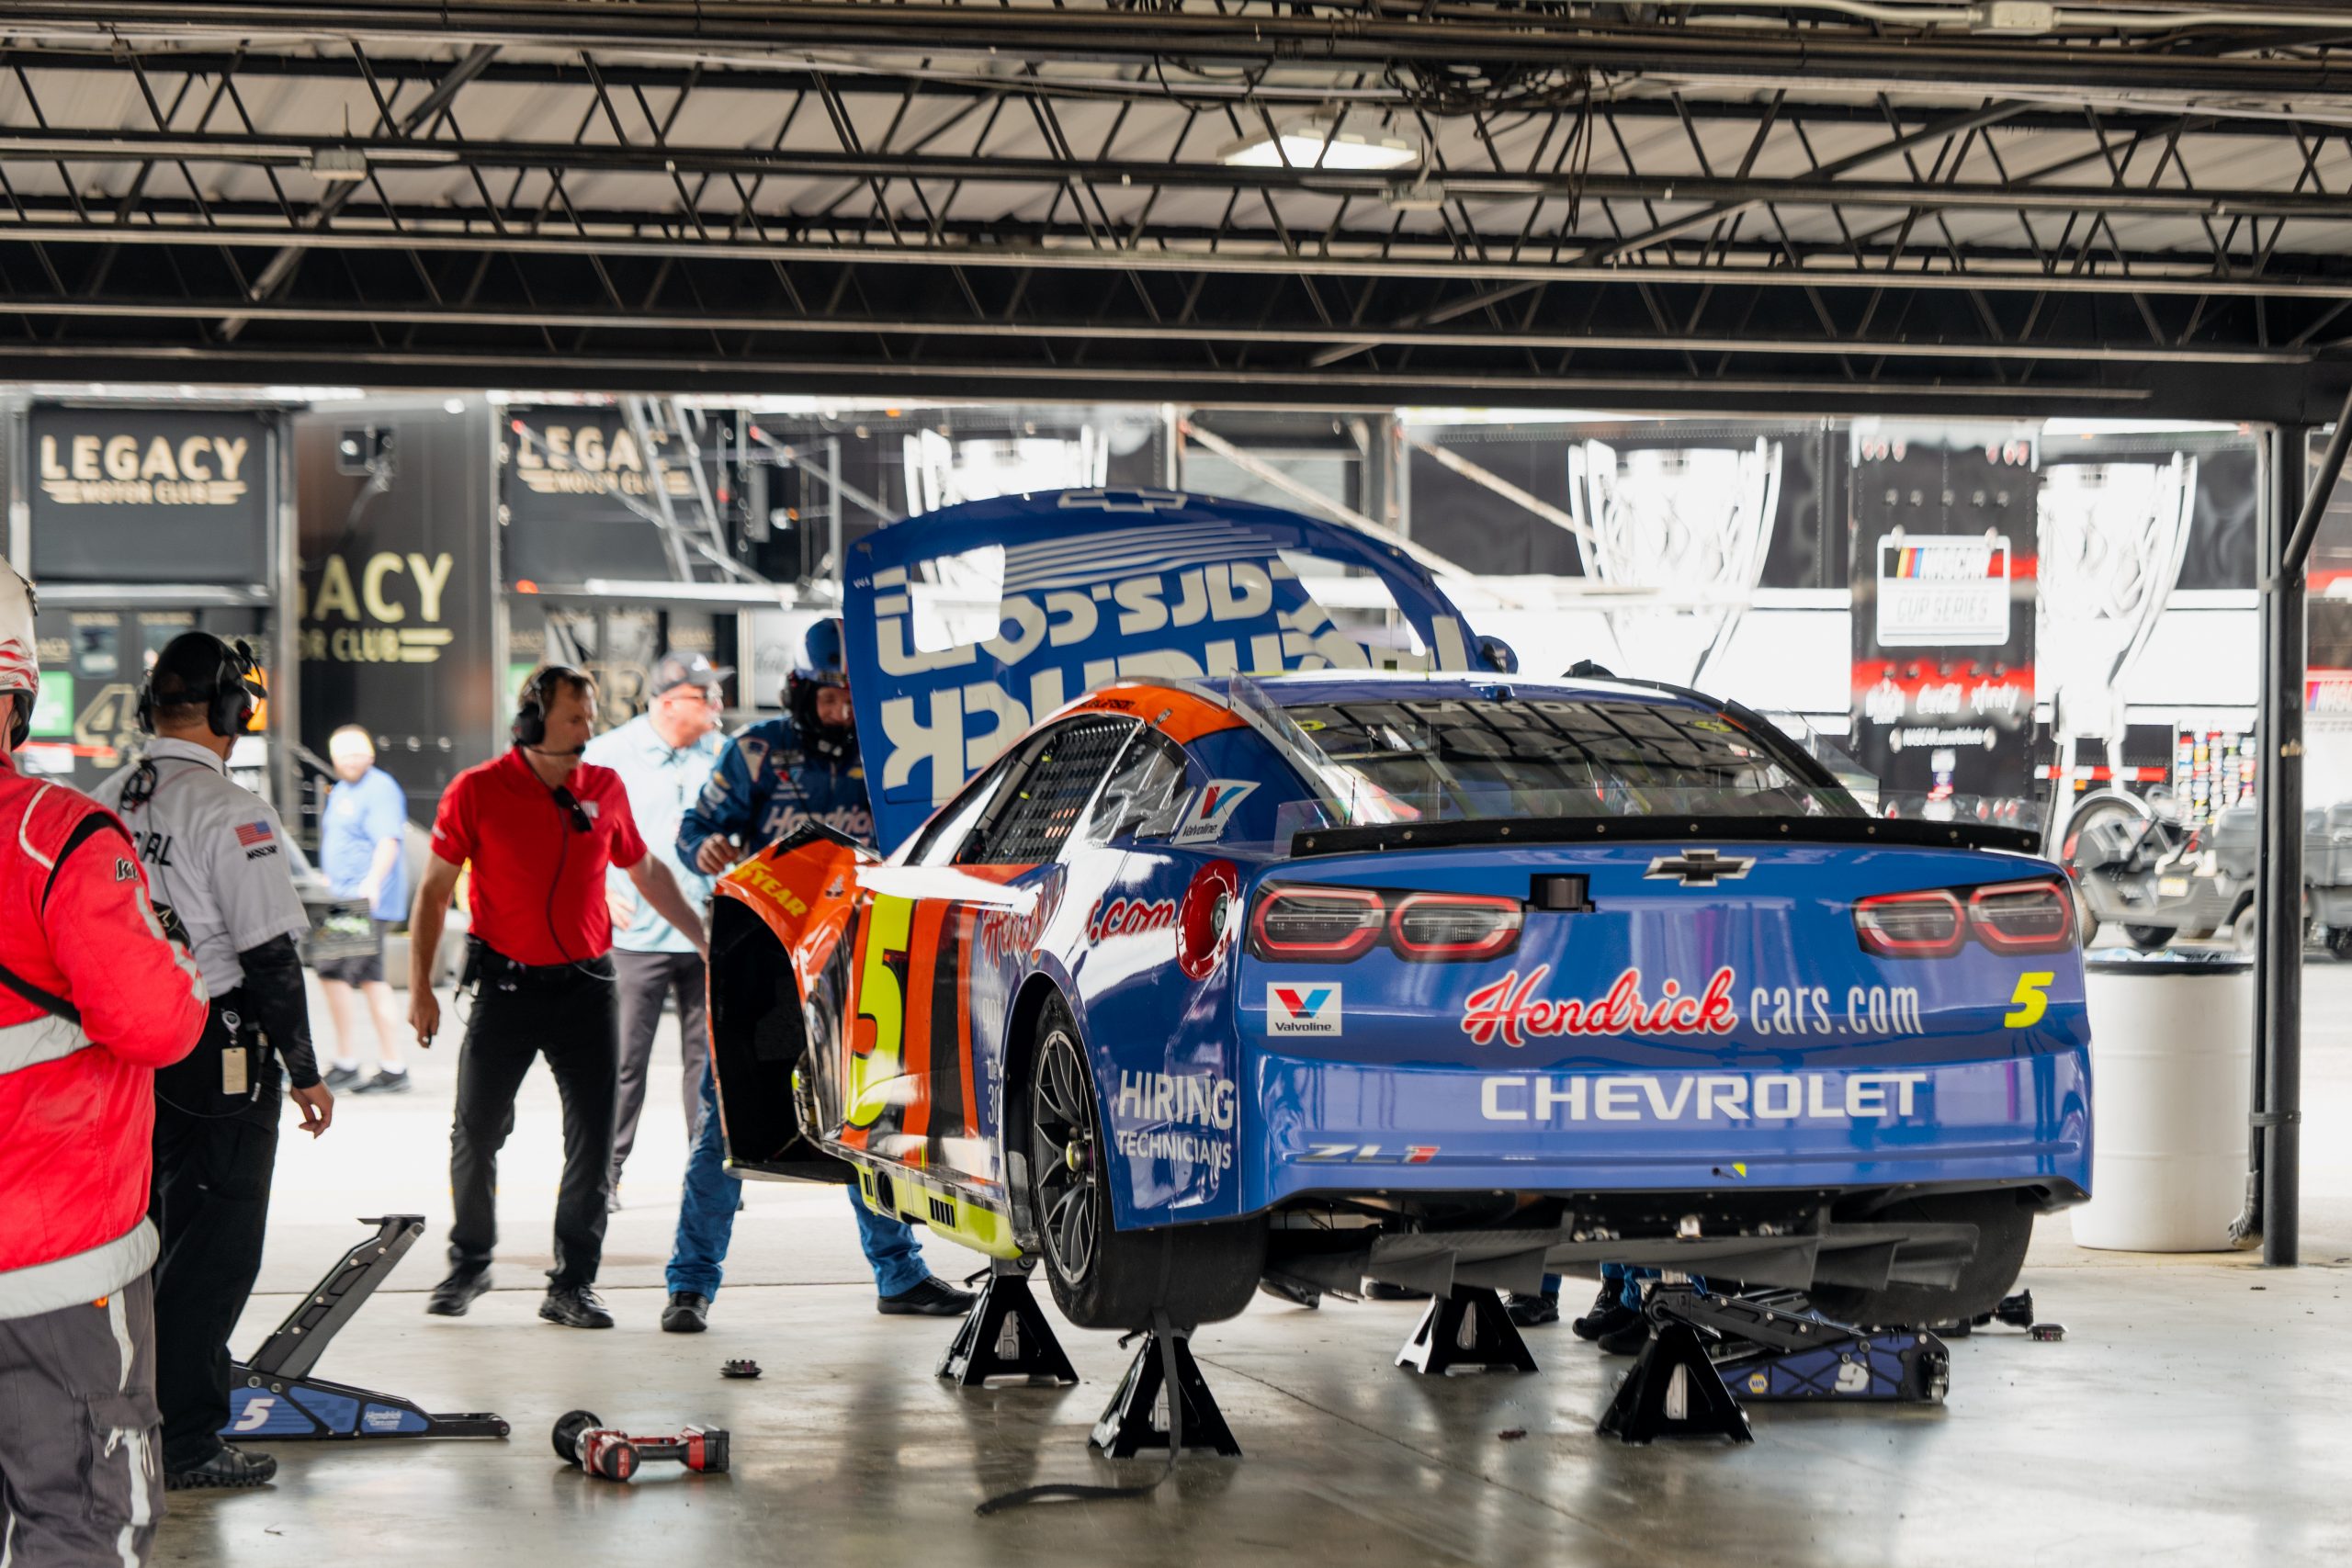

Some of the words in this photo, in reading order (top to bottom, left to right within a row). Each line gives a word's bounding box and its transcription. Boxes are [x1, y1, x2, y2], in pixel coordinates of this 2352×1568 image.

[40, 434, 248, 480] LEGACY
[299, 551, 454, 623] ACY
[843, 891, 915, 1129] 5
[1275, 1022, 1331, 1032] Valvoline
[1462, 964, 1738, 1048] Hendrick
[1751, 986, 1926, 1035] cars.com
[2004, 971, 2054, 1029] 5
[1118, 1069, 1235, 1130] HIRING
[1481, 1072, 1927, 1122] CHEVROLET
[1117, 1130, 1232, 1169] TECHNICIANS
[233, 1398, 276, 1431] 5
